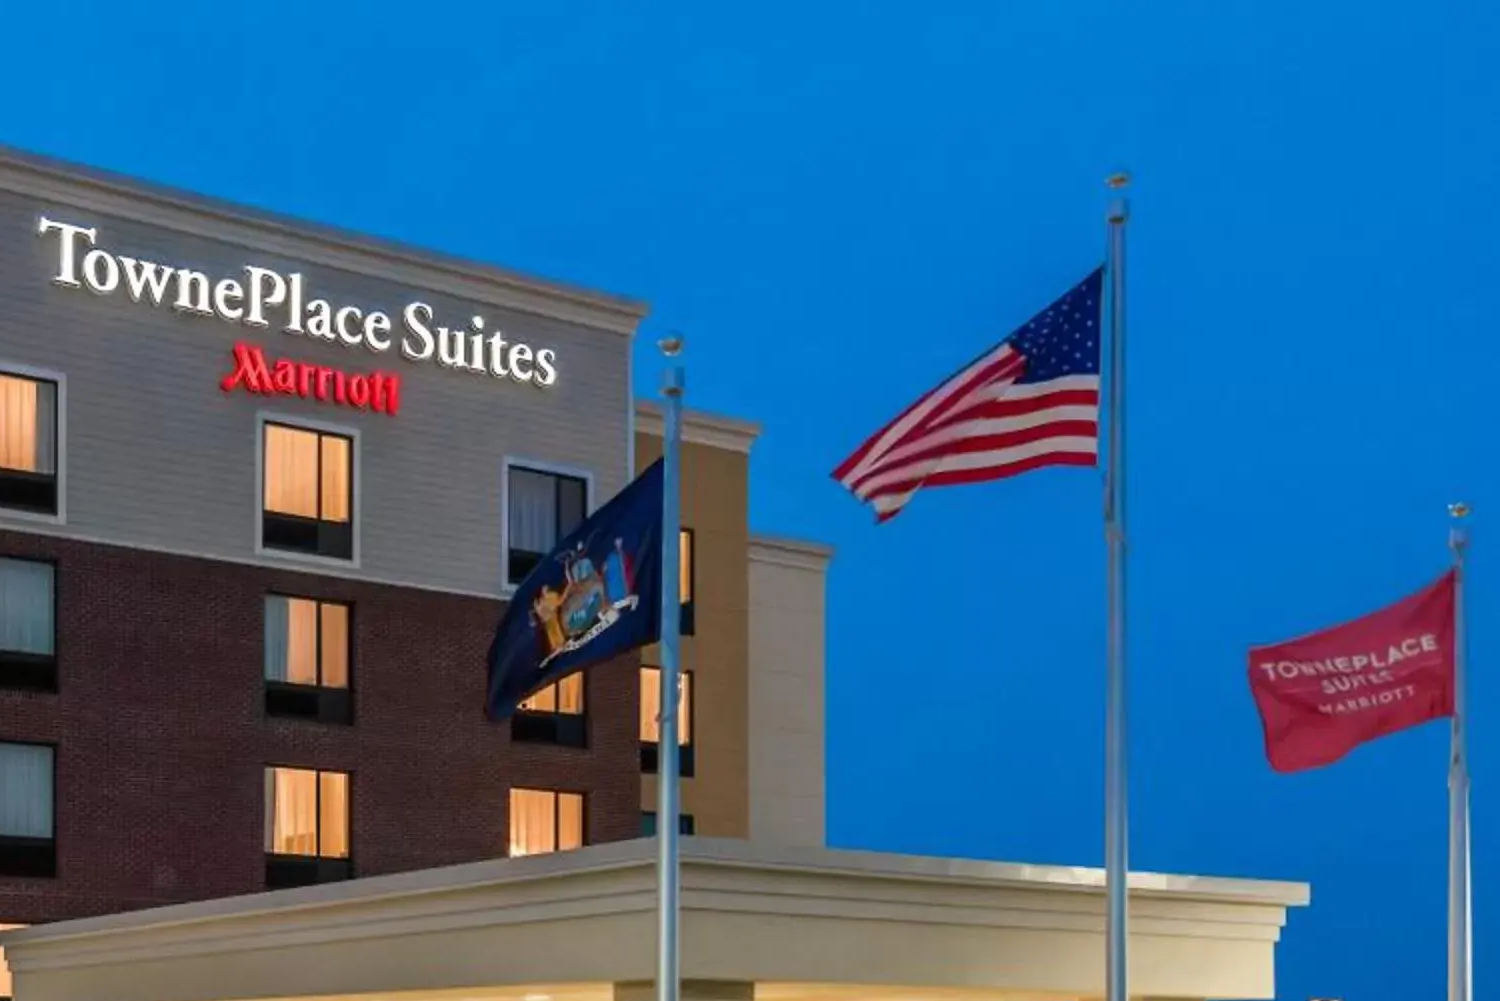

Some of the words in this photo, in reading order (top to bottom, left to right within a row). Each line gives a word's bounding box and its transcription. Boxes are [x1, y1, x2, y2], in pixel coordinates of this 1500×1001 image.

[38, 217, 392, 351] TownePlace
[401, 302, 558, 386] Suites
[220, 340, 400, 415] Marriott
[1260, 634, 1439, 681] TOWNEPLACE
[1318, 685, 1416, 715] MARRIOTT
